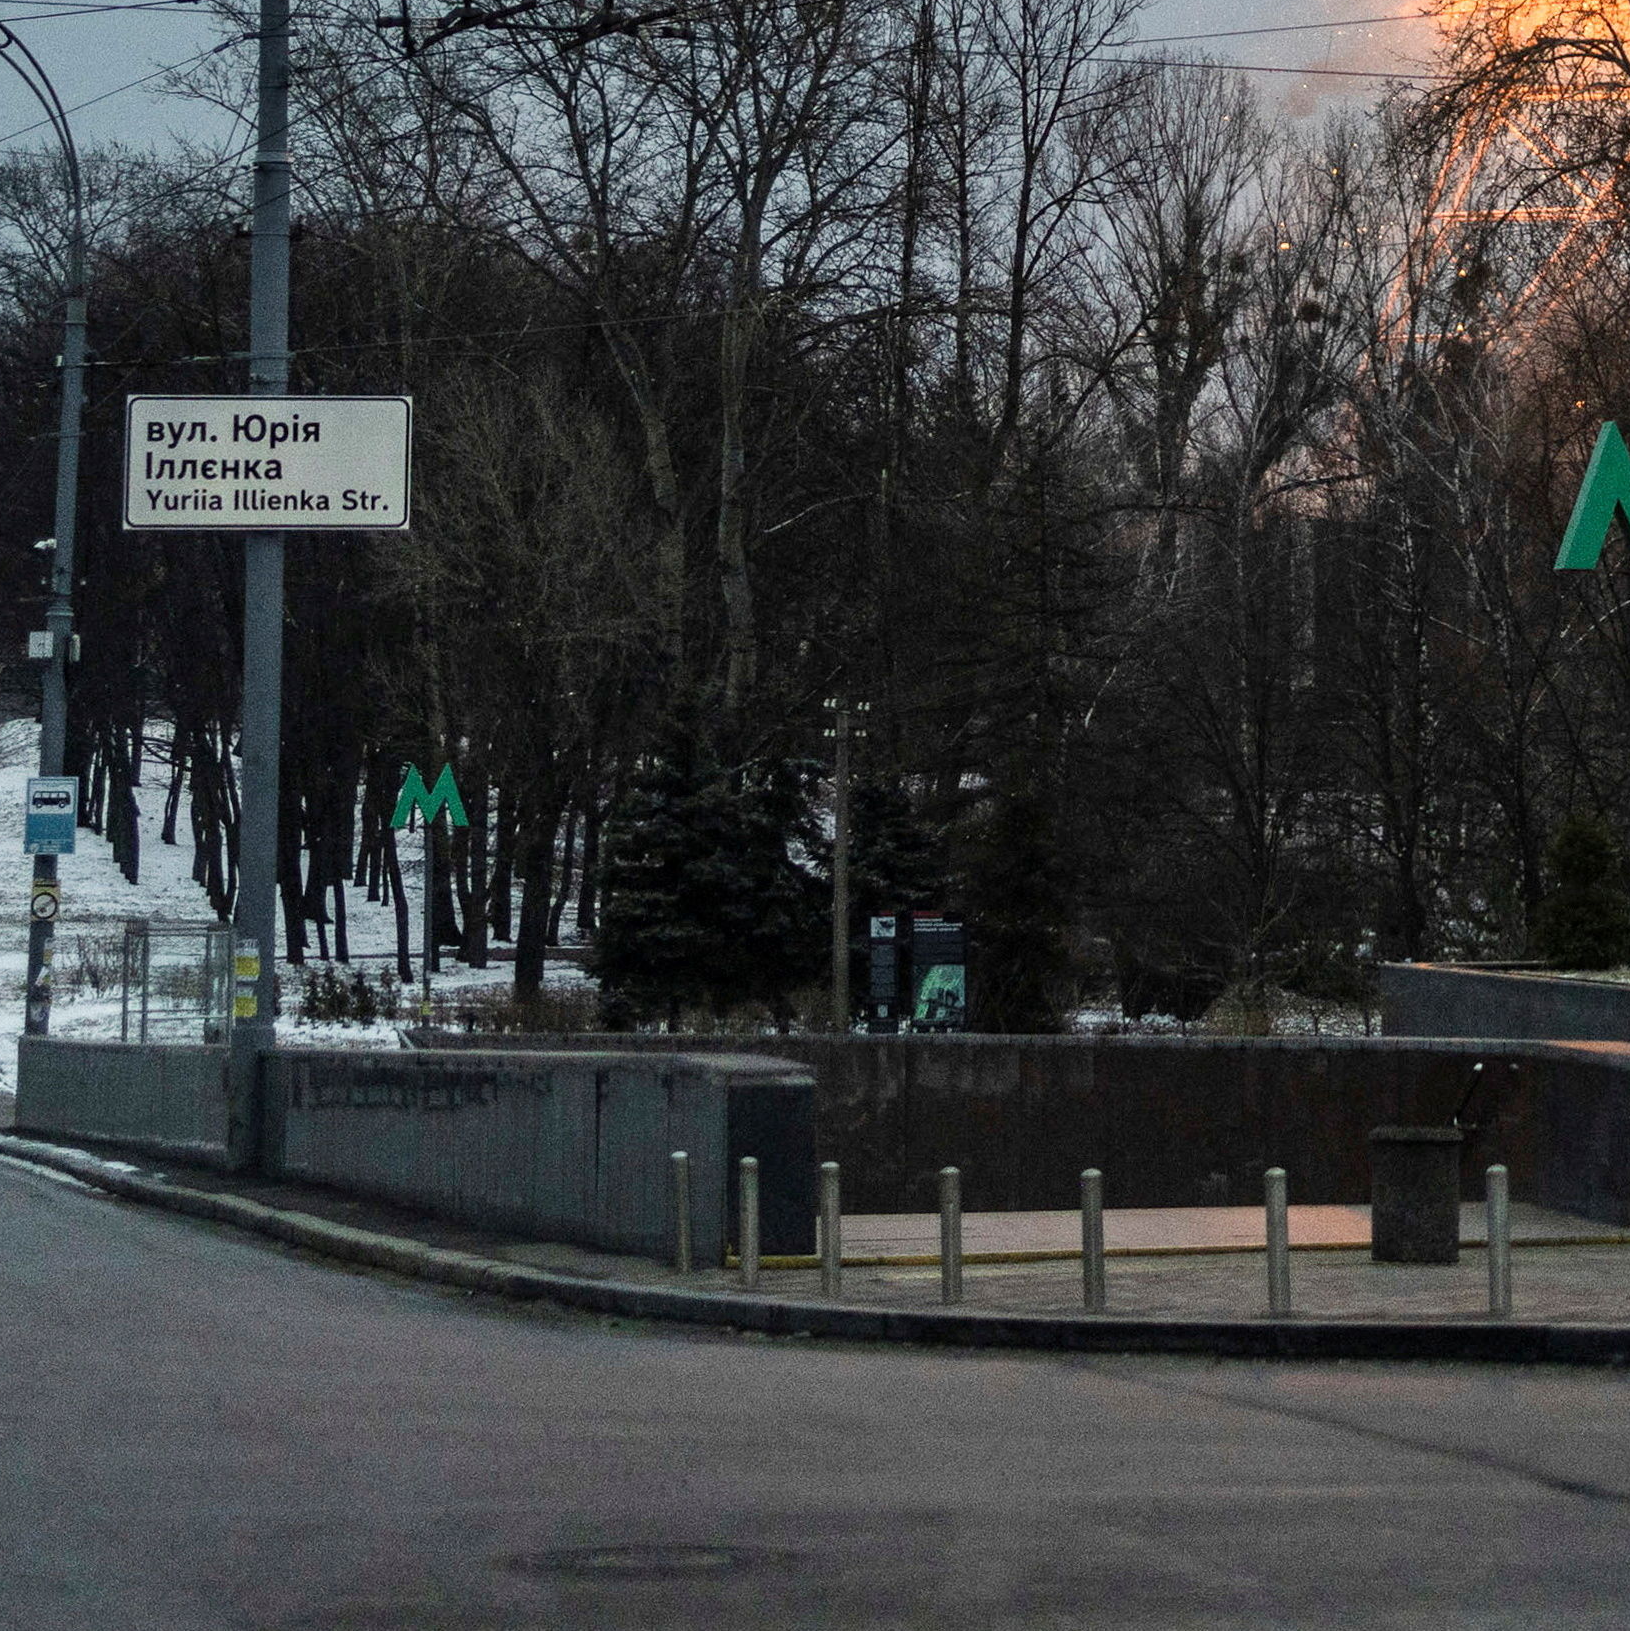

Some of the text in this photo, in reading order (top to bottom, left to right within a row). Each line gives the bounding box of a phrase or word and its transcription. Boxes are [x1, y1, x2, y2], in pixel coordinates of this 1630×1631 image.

[147, 414, 320, 449] вул. Юрія
[145, 451, 283, 480] Іллєнка
[146, 489, 389, 511] Yuriia Illienka Str.
